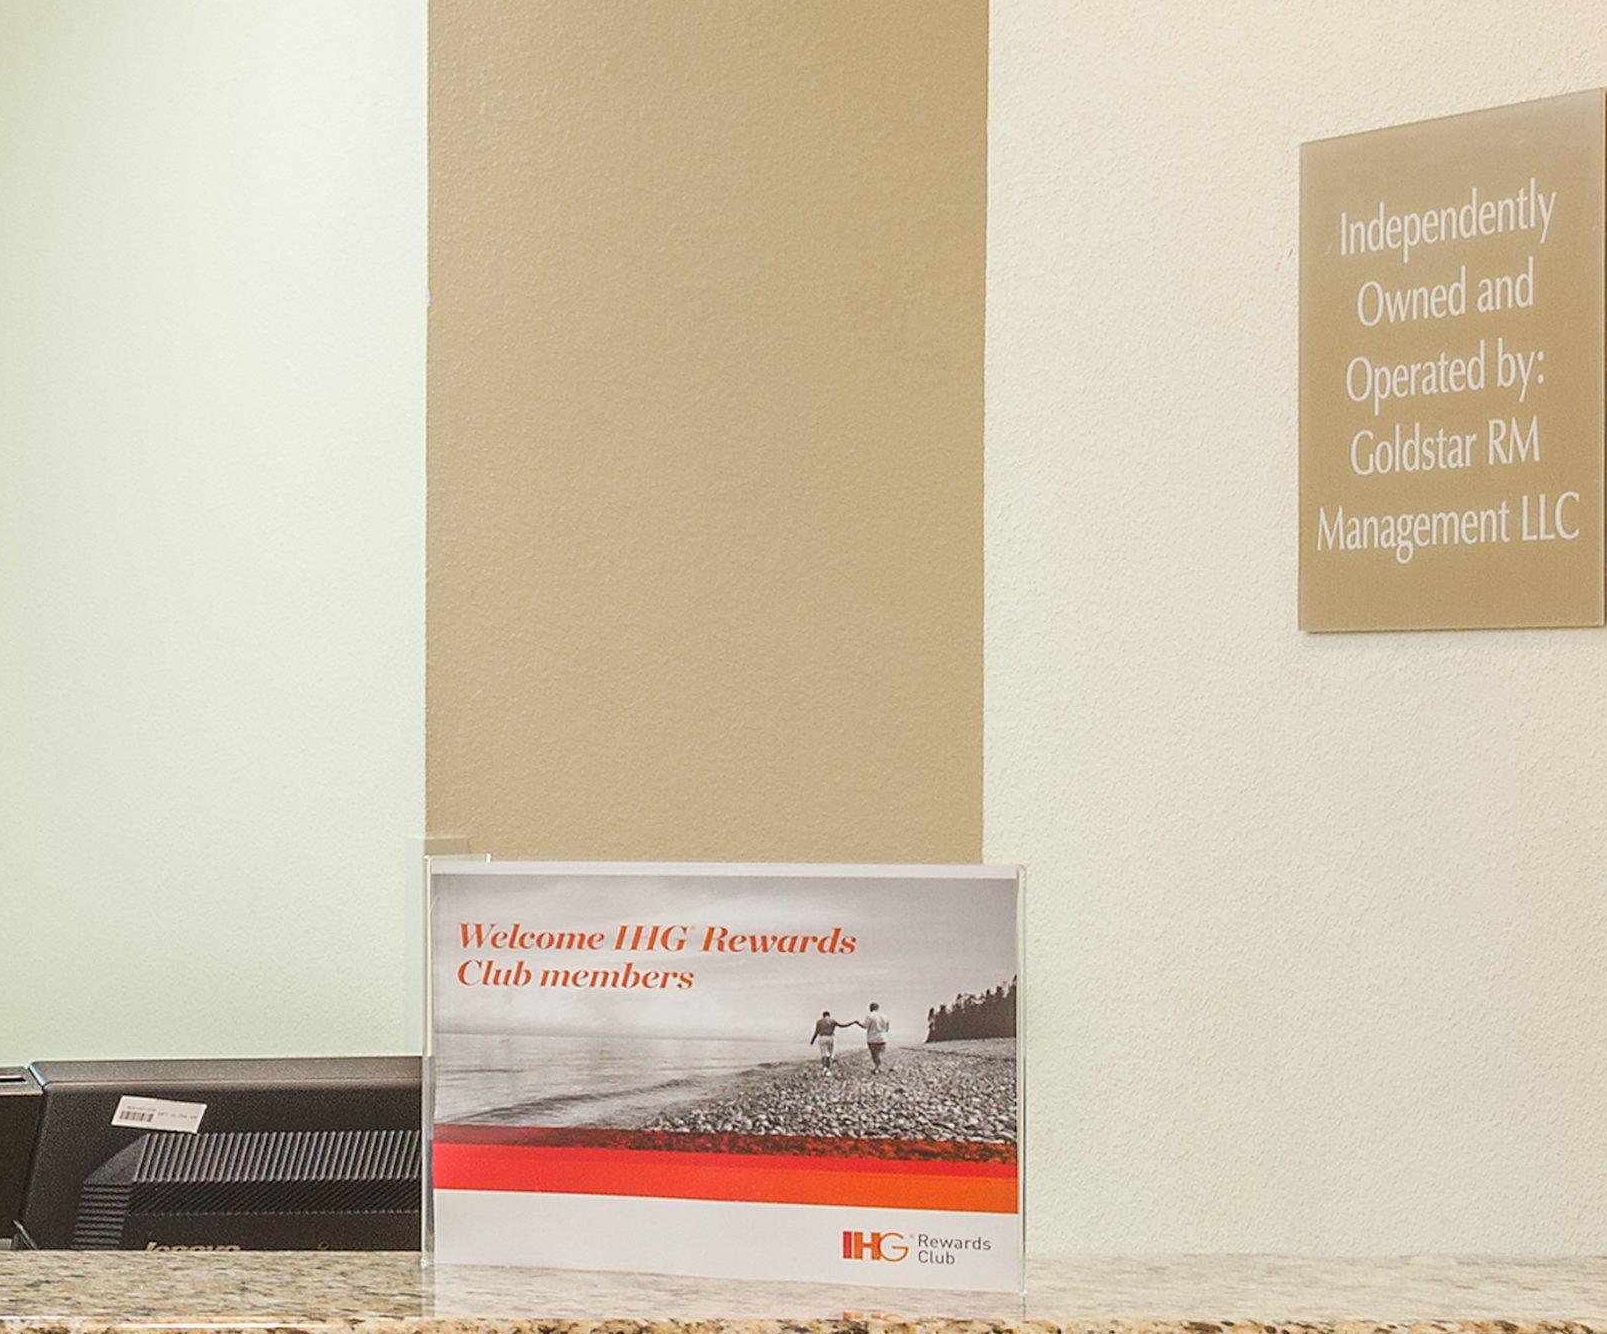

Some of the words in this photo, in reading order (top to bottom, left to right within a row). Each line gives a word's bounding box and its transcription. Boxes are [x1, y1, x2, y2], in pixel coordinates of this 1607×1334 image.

[1338, 177, 1557, 263] Independently
[1357, 265, 1467, 327] Owned
[1477, 256, 1534, 313] and
[1346, 338, 1485, 415] Operated
[1496, 337, 1545, 403] by:
[1350, 424, 1476, 476] Goldstar
[1487, 415, 1540, 466] RM
[1316, 499, 1510, 563] Management
[1520, 491, 1580, 541] LLC
[459, 923, 604, 951] Welcome
[701, 926, 857, 954] Rewards
[457, 959, 532, 987] Club
[540, 962, 694, 990] members
[842, 1230, 910, 1262] IHG
[918, 1234, 991, 1253] Rewards
[918, 1250, 956, 1265] Club
